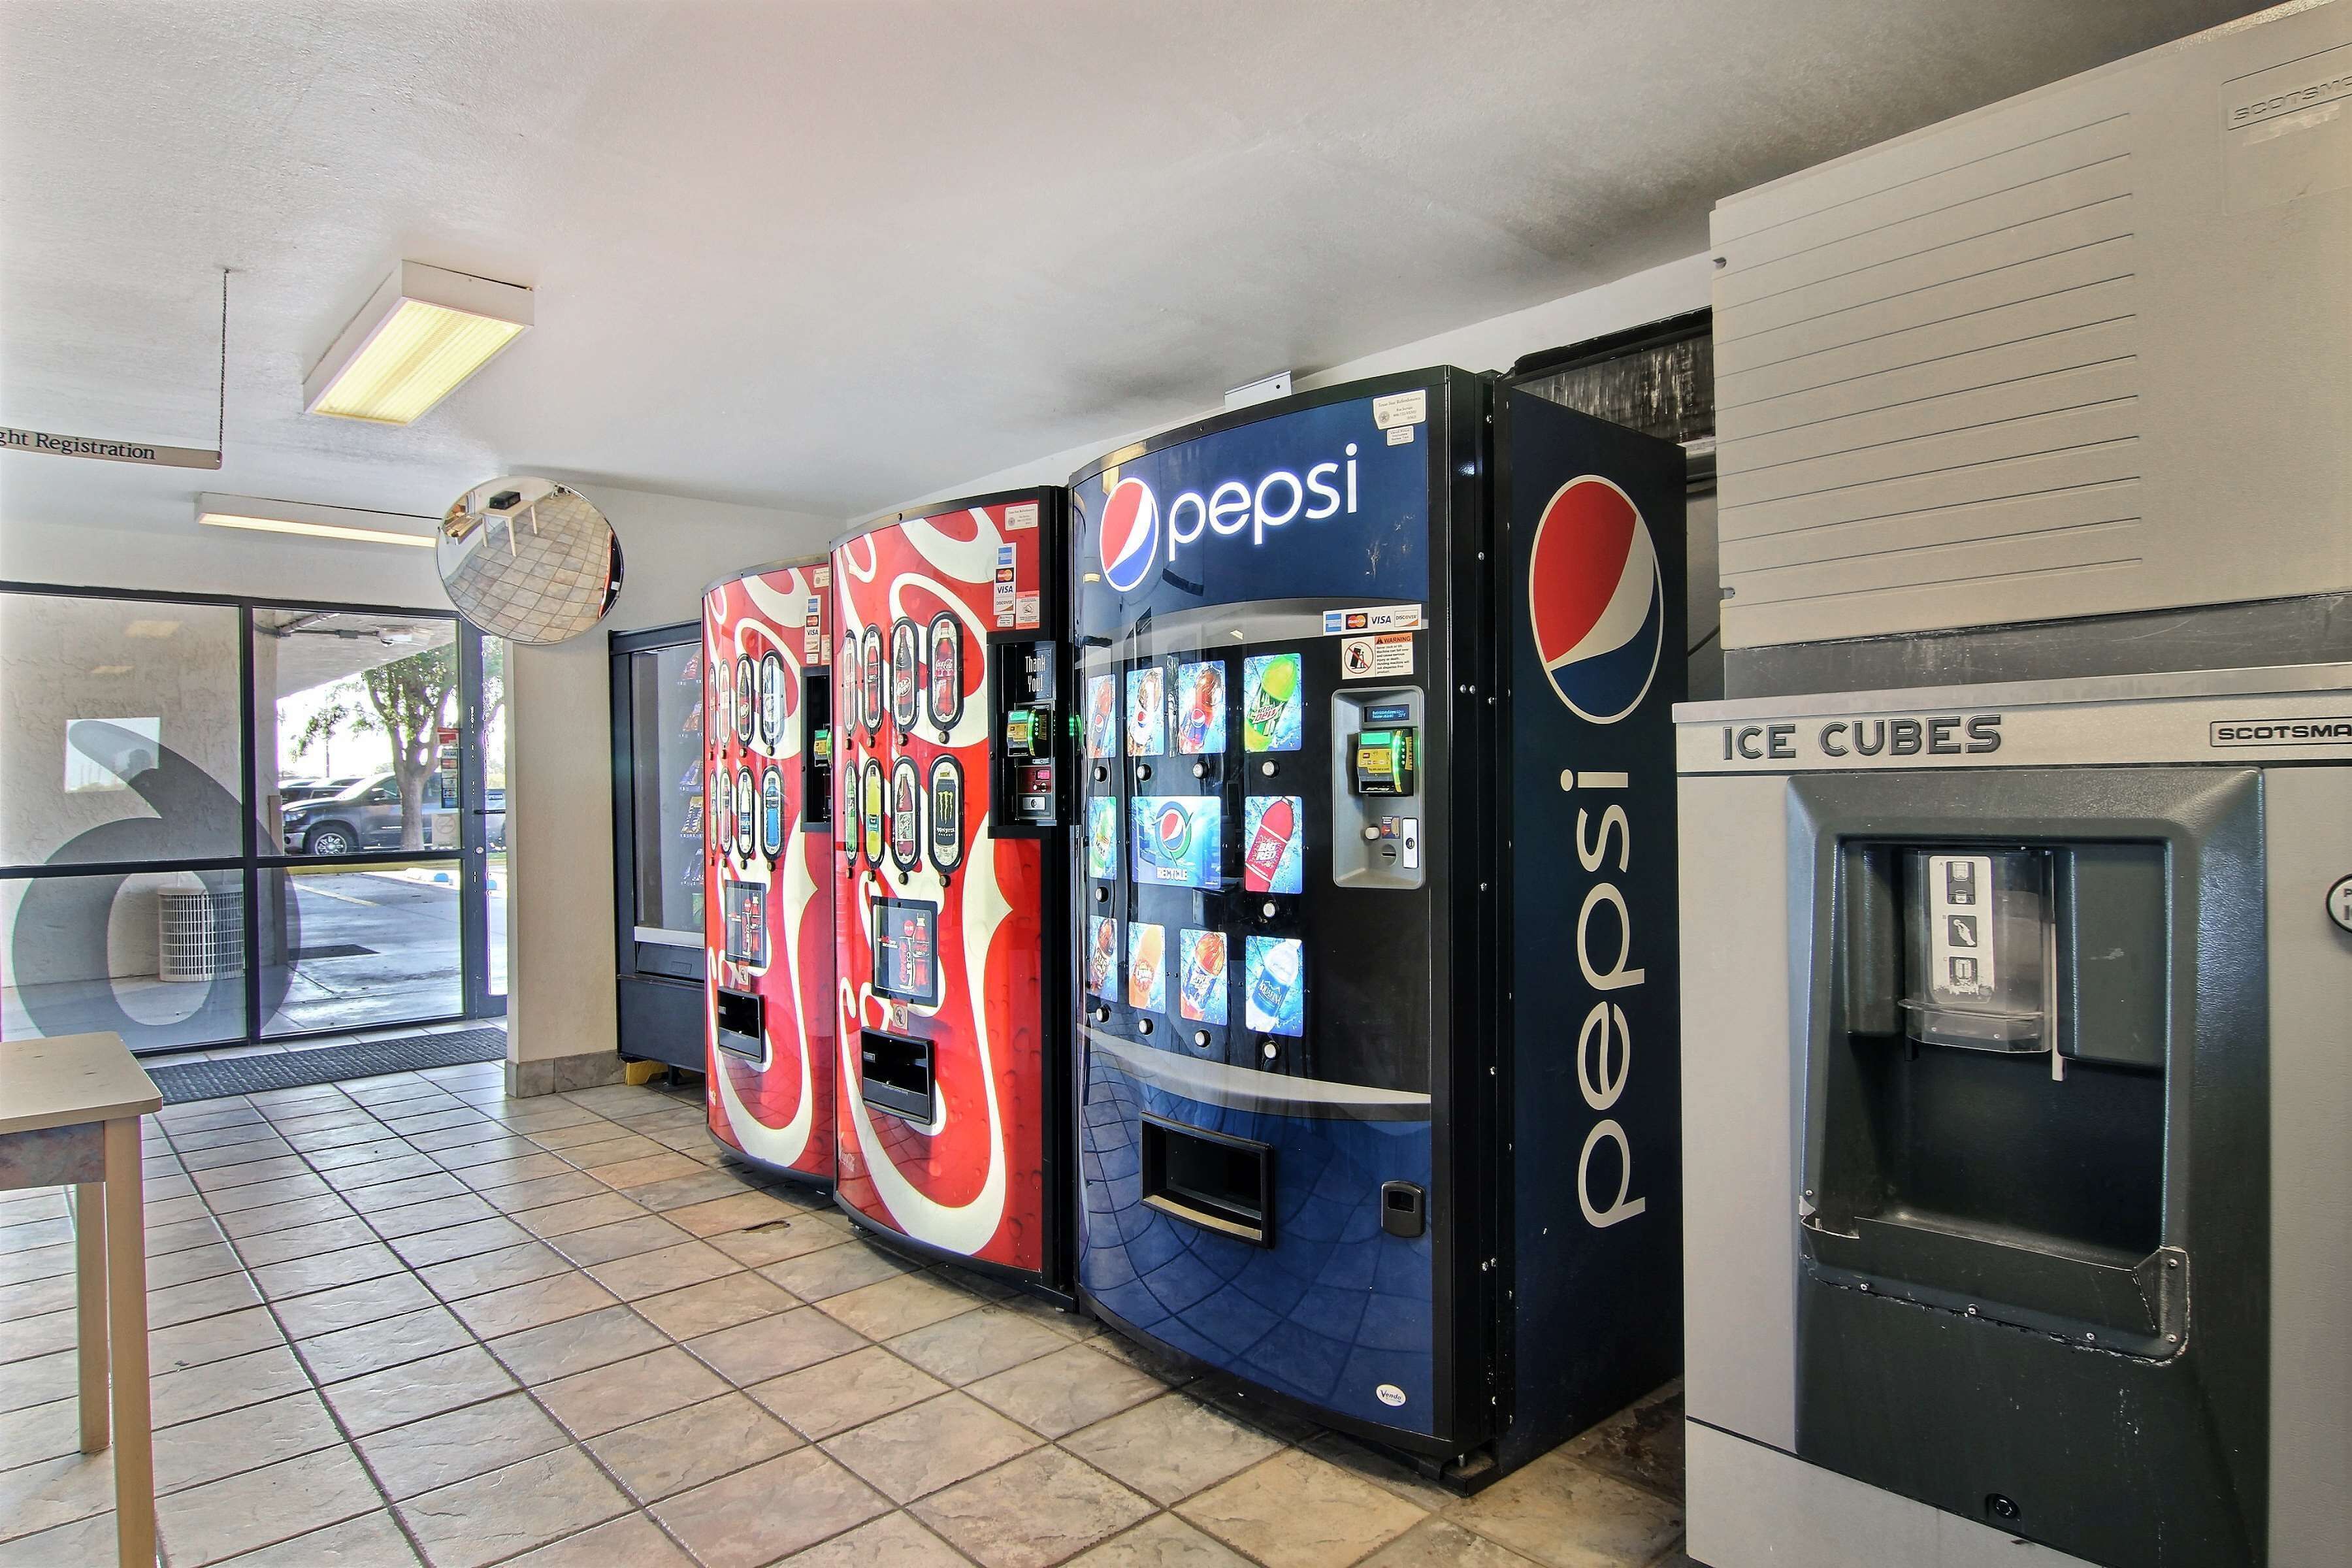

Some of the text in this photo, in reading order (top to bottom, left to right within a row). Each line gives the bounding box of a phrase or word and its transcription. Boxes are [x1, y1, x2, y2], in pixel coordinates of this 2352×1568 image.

[36, 433, 156, 460] Registration
[1168, 442, 1358, 562] pepsi
[997, 585, 1013, 594] VISA
[1371, 615, 1392, 625] VISA
[1024, 654, 1046, 673] Thank
[1028, 674, 1043, 693] You!
[1722, 713, 2002, 760] ICE CUBES
[2217, 723, 2352, 740] SCOTSMA
[1156, 866, 1188, 881] RECYCLE
[1560, 768, 1646, 1229] pepsi
[1379, 1389, 1401, 1400] Vendo
